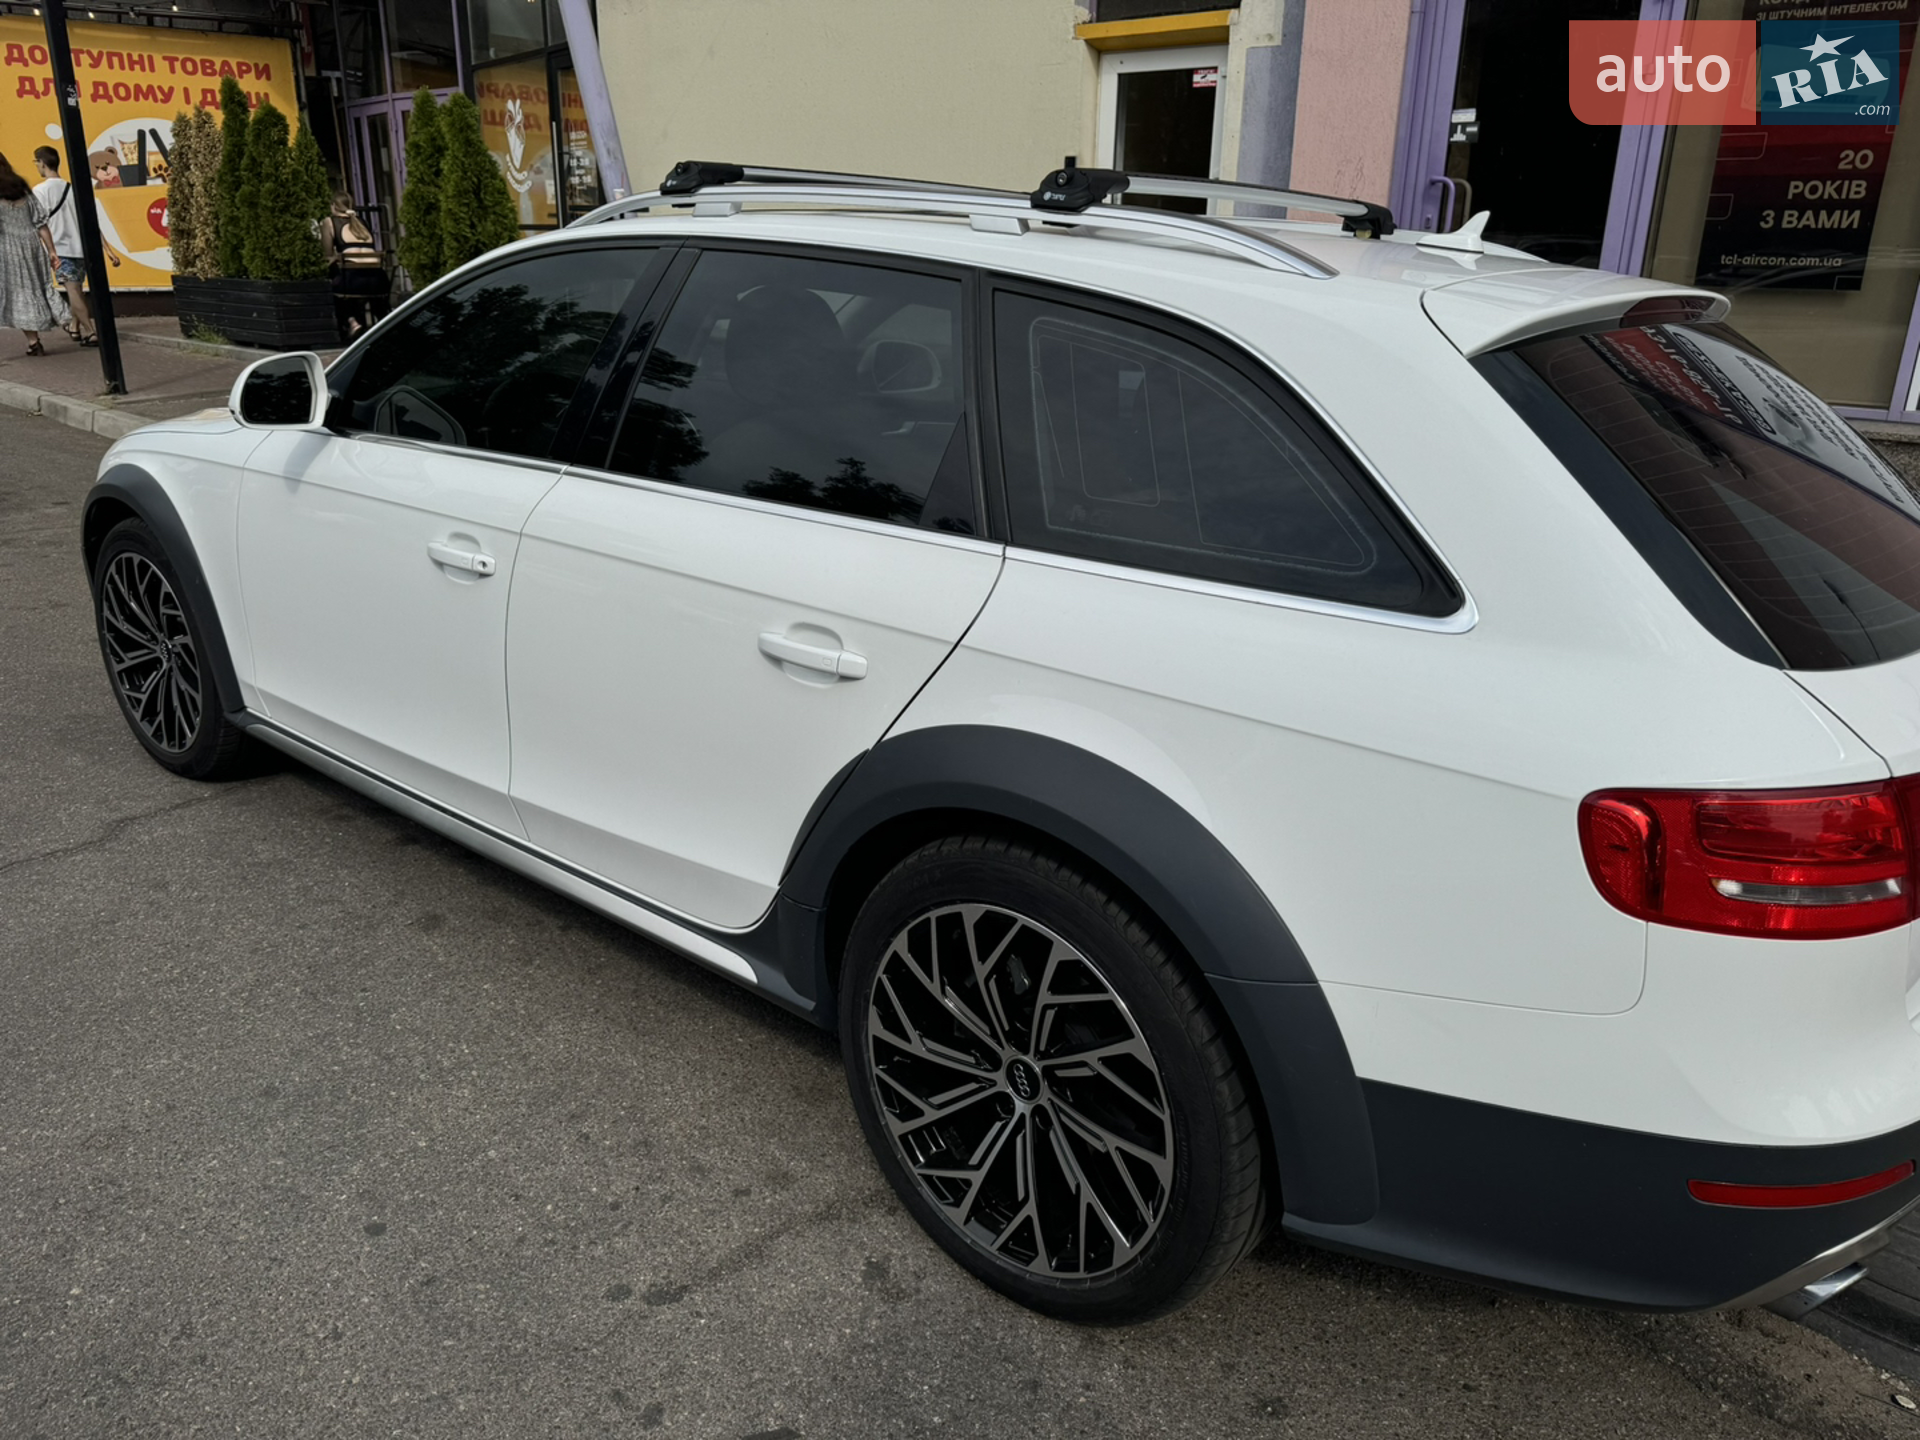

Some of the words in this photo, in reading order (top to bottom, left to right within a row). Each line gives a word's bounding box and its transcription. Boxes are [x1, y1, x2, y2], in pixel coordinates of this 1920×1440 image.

[1769, 7, 1827, 21] ШТУЧНИМ
[1830, 0, 1908, 15] ІНТЕЛЕКТОМ
[4, 43, 156, 73] ДОТУПНІ
[162, 55, 272, 82] ТОВАРИ
[90, 80, 175, 104] ДОМУ
[182, 86, 192, 105] І
[1837, 149, 1874, 170] 20
[1787, 180, 1868, 200] РОКІВ
[1781, 209, 1862, 229] ВАМИ
[1720, 253, 1843, 267] tcl-aircon.com.ua
